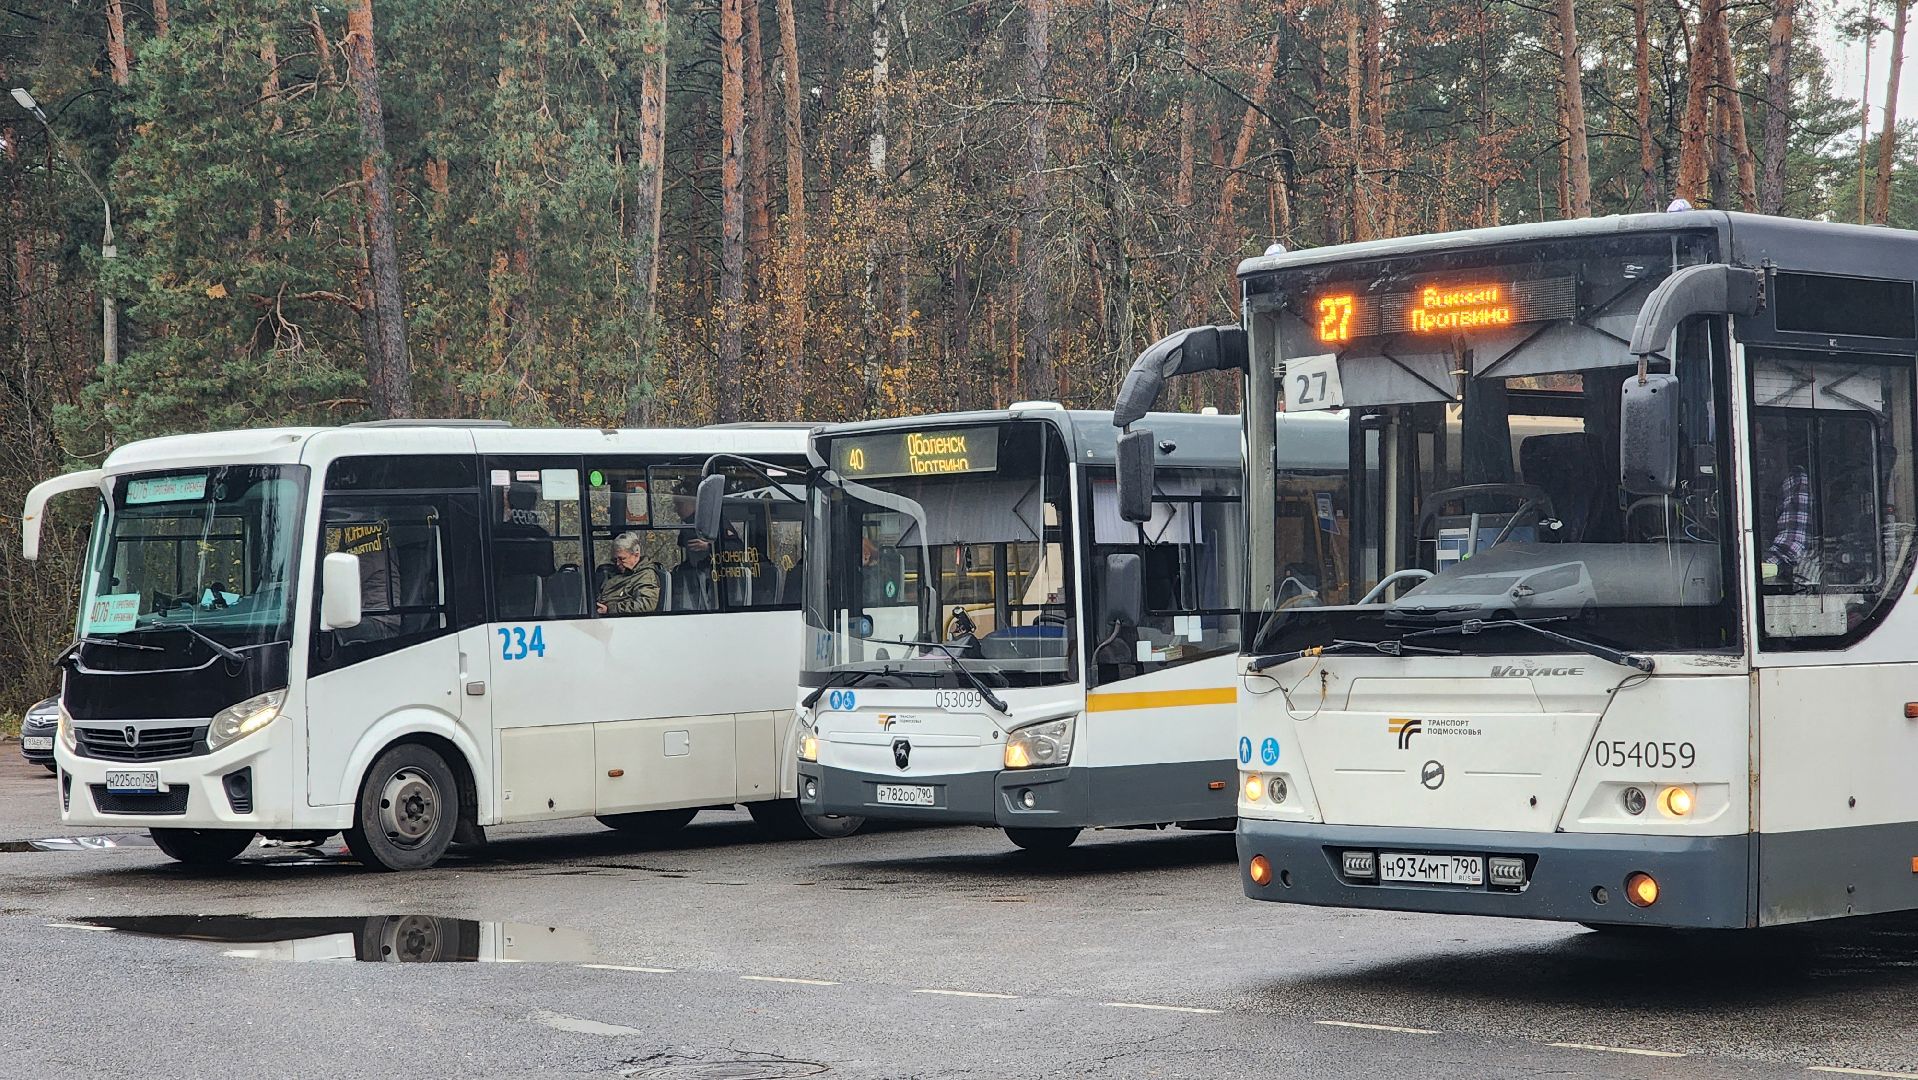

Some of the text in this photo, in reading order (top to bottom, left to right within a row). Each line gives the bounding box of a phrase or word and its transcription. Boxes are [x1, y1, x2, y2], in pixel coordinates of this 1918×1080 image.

[1320, 296, 1352, 341] 27
[1412, 308, 1510, 331] Протвино
[1296, 371, 1328, 405] 27
[907, 434, 968, 456] Оболенск
[849, 448, 864, 471] 40
[498, 625, 546, 660] 234
[935, 691, 982, 708] 053099
[1427, 728, 1482, 736] ПОДМОСКОВЬЯ
[1428, 719, 1470, 727] ТРАНСПОРТ
[1595, 740, 1696, 769] 054059
[109, 773, 155, 787] Н225СО 750
[880, 787, 916, 802] Р782ОО
[917, 787, 931, 799] 790
[1386, 857, 1478, 880] Н934МТ 790
